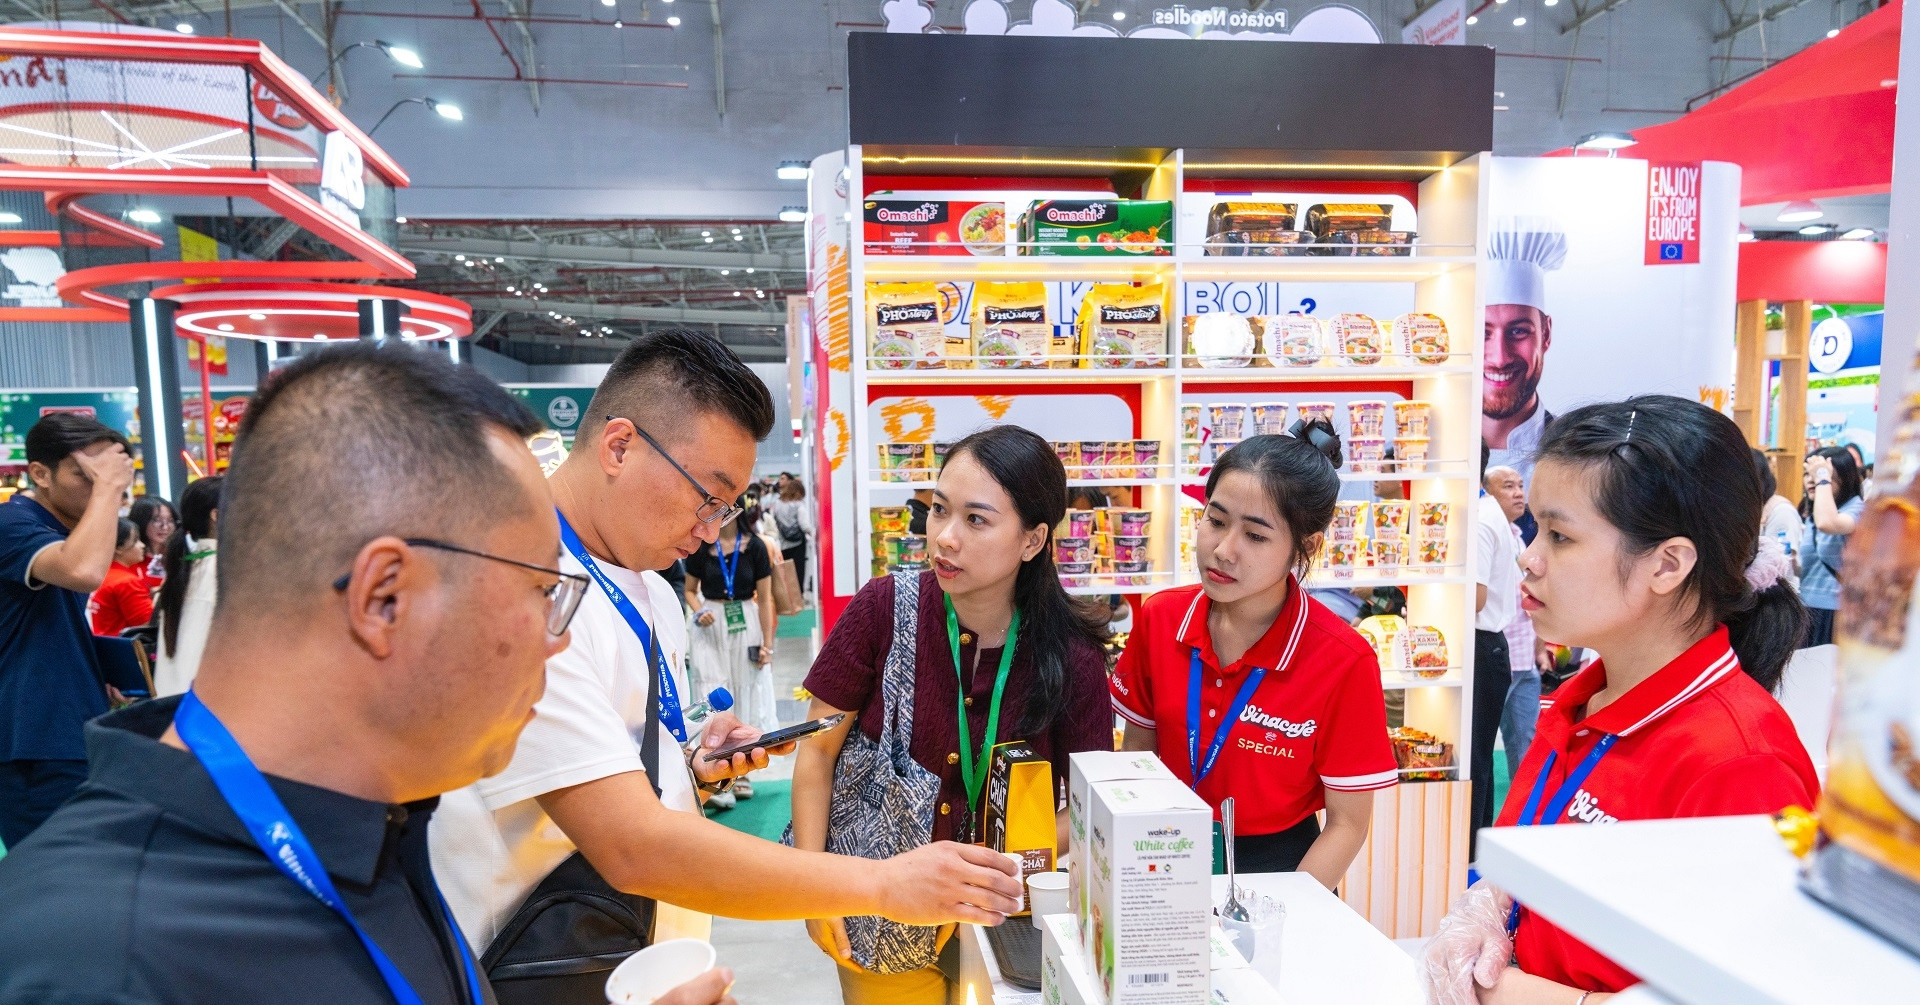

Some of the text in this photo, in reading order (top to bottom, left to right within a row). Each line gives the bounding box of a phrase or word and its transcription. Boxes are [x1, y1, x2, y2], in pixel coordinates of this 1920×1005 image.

[1650, 166, 1699, 197] ENJOY
[877, 207, 929, 221] Omachi
[1047, 207, 1097, 221] Omachi
[1650, 197, 1697, 217] IT'S FROM
[1649, 217, 1697, 241] EUROPE
[1239, 703, 1317, 738] Vinacafé
[1237, 737, 1296, 759] SPECIAL
[1147, 828, 1181, 837] wake-up
[1133, 836, 1195, 853] White coffee
